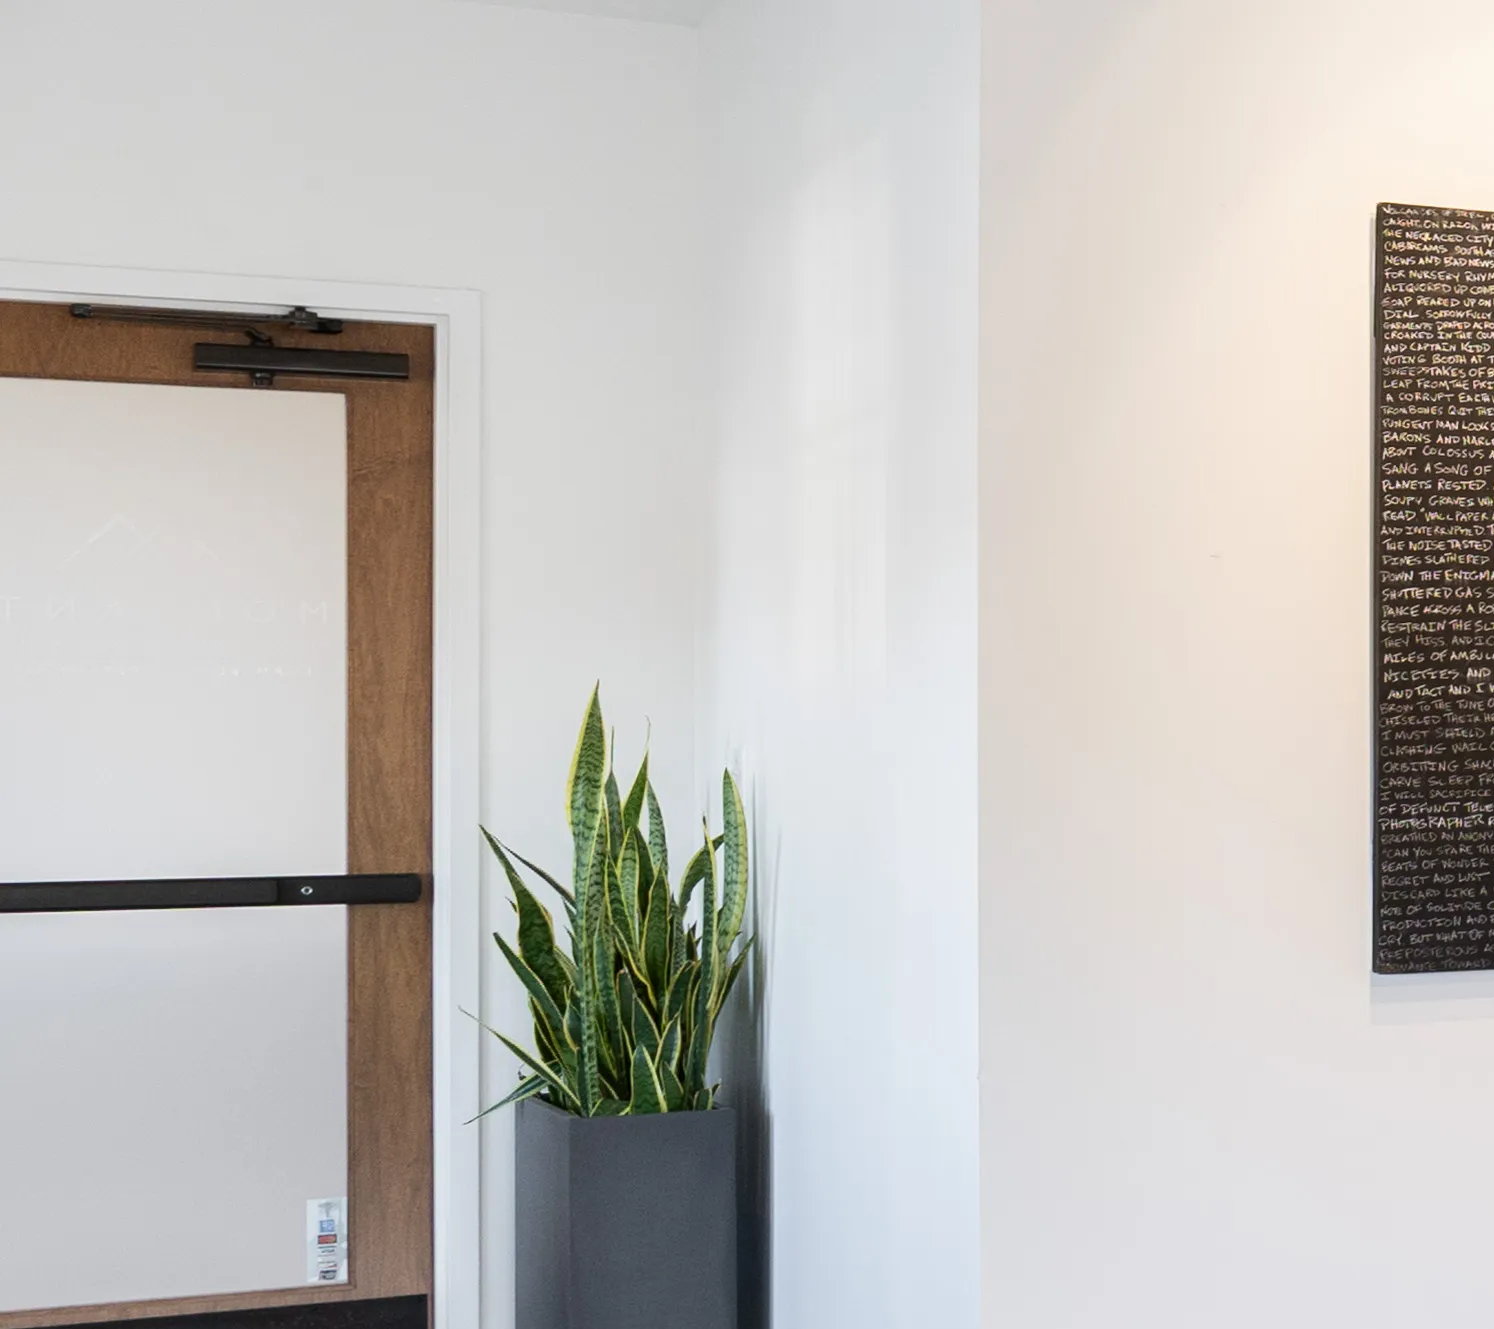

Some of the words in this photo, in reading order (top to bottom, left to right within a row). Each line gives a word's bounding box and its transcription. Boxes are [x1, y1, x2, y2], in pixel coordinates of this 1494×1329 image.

[1466, 235, 1494, 247] CITY
[1409, 269, 1461, 282] NURSERY
[1382, 355, 1426, 365] VOTING
[1431, 355, 1467, 365] BOOTH
[1470, 355, 1485, 364] AT
[1381, 462, 1419, 475] SANG
[1424, 463, 1432, 473] A
[1433, 463, 1469, 477] SONG
[1473, 464, 1493, 475] OF
[1381, 479, 1432, 491] PLANETS
[1424, 553, 1490, 565] SLATHERED
[1382, 587, 1453, 602] SHUTTERED
[1455, 586, 1482, 599] GAS
[1383, 652, 1425, 664] MILES
[1430, 651, 1448, 662] OF
[1387, 689, 1414, 700] AND
[1414, 684, 1446, 697] TACT
[1448, 683, 1472, 696] AND
[1475, 683, 1488, 694] I
[1378, 804, 1396, 815] OF
[1400, 801, 1460, 815] DEFUNCT
